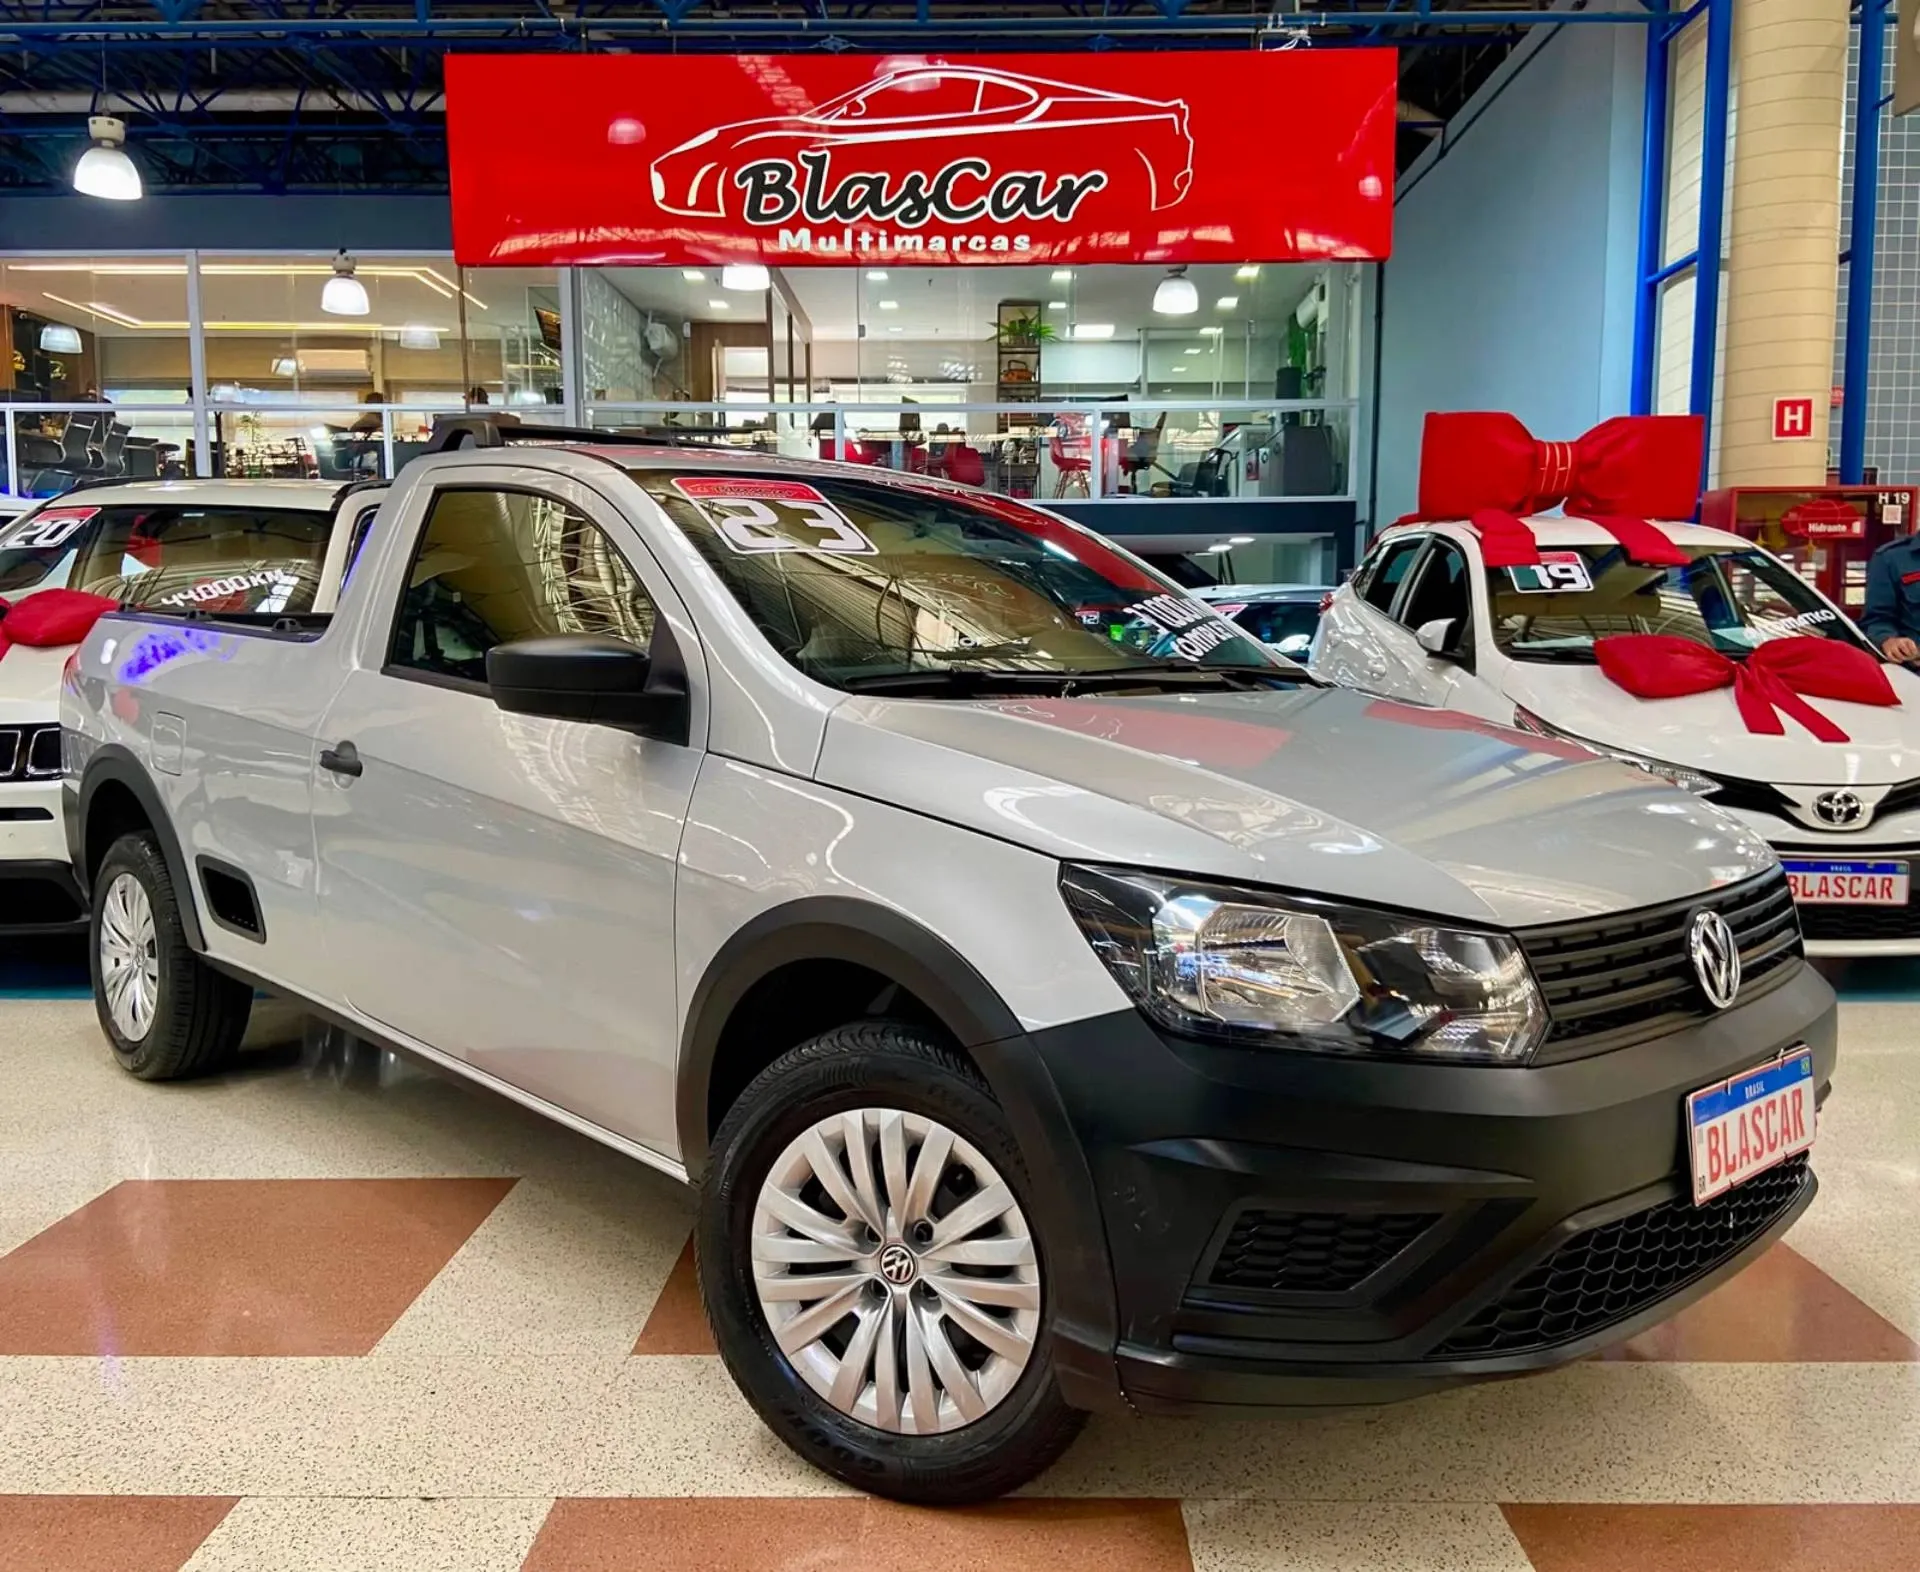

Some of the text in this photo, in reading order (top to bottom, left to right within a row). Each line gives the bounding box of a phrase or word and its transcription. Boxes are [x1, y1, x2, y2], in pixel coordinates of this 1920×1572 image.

[735, 150, 1108, 228] BlasCar
[778, 228, 1031, 252] Multimarcas
[1783, 405, 1805, 432] H
[1878, 492, 1911, 505] H 19
[5, 519, 81, 546] 20
[708, 499, 867, 551] 23
[1808, 522, 1848, 534] Hidrante
[1530, 563, 1589, 590] 19
[1169, 620, 1239, 662] COMPLET
[1787, 874, 1894, 900] BLASCAR
[1744, 1080, 1766, 1100] BRASIL
[1707, 1086, 1806, 1185] BLASCAR
